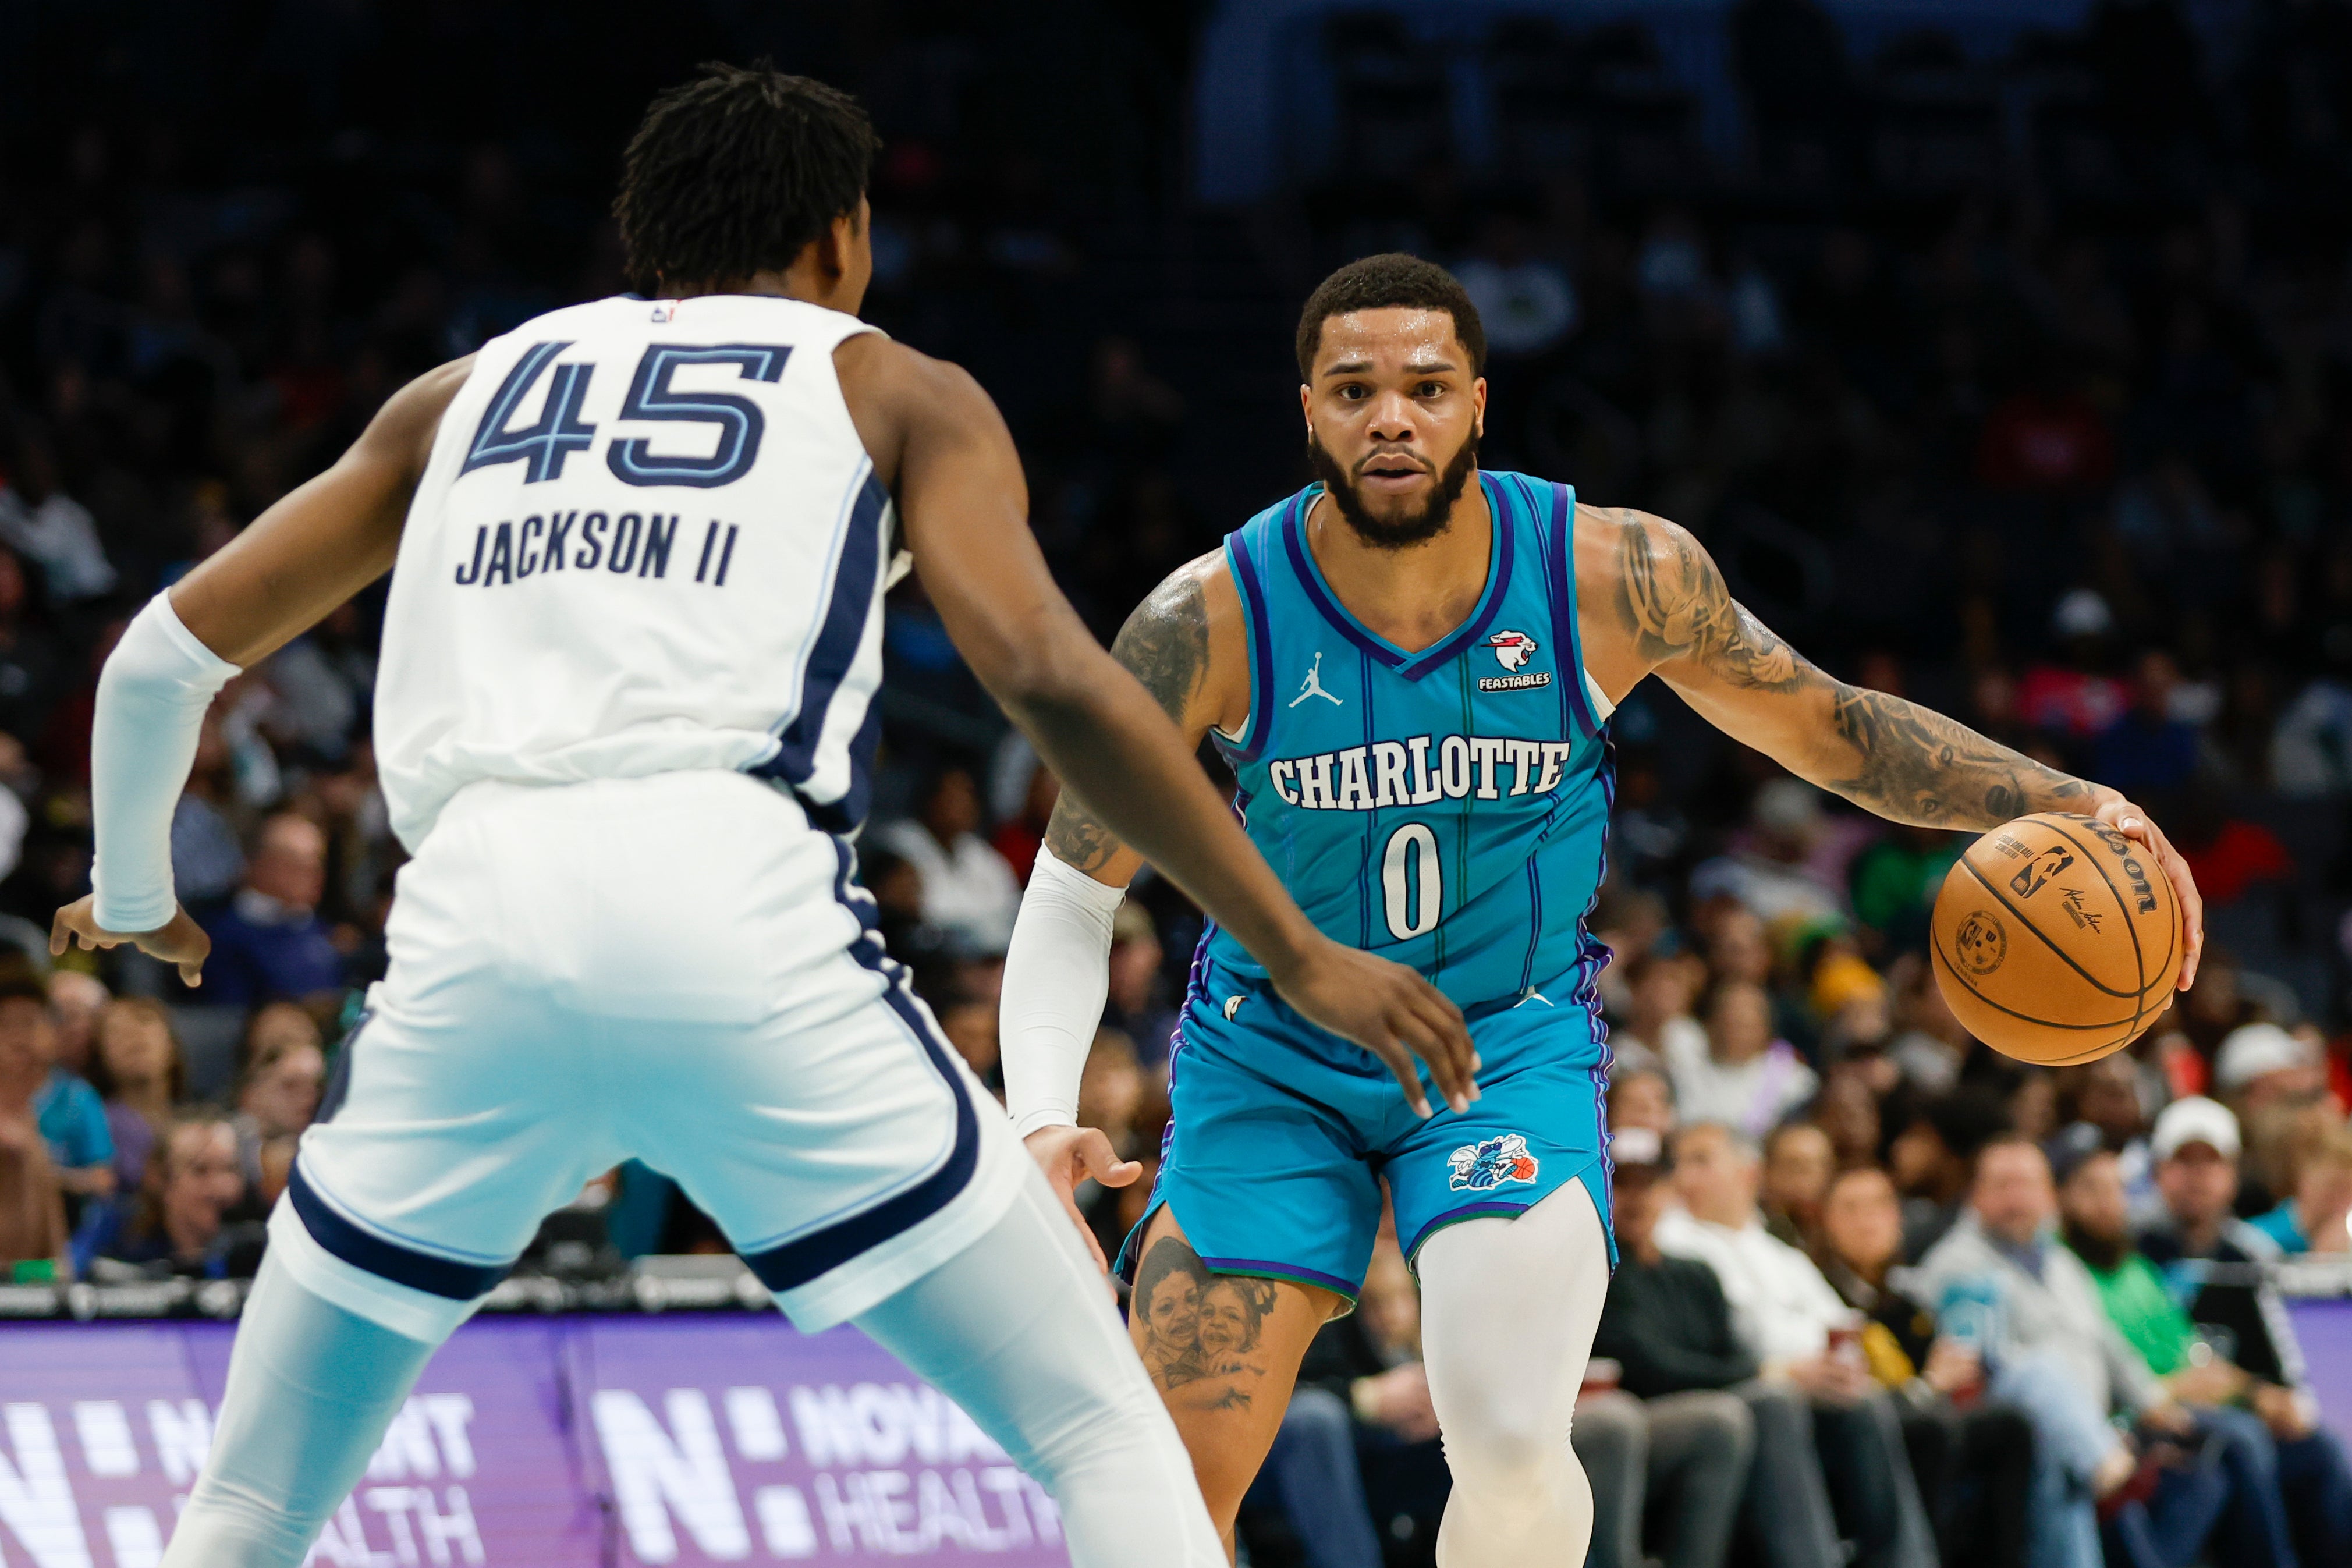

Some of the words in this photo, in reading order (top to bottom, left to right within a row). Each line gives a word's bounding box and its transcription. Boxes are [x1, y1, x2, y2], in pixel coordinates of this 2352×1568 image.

[457, 340, 794, 488] 45
[455, 508, 680, 587] JACKSON
[694, 519, 739, 587] II
[1479, 672, 1550, 690] FEASTABLES
[1269, 734, 1571, 810] CHARLOTTE
[1382, 822, 1443, 941] 0
[790, 1382, 1016, 1467] NOVA
